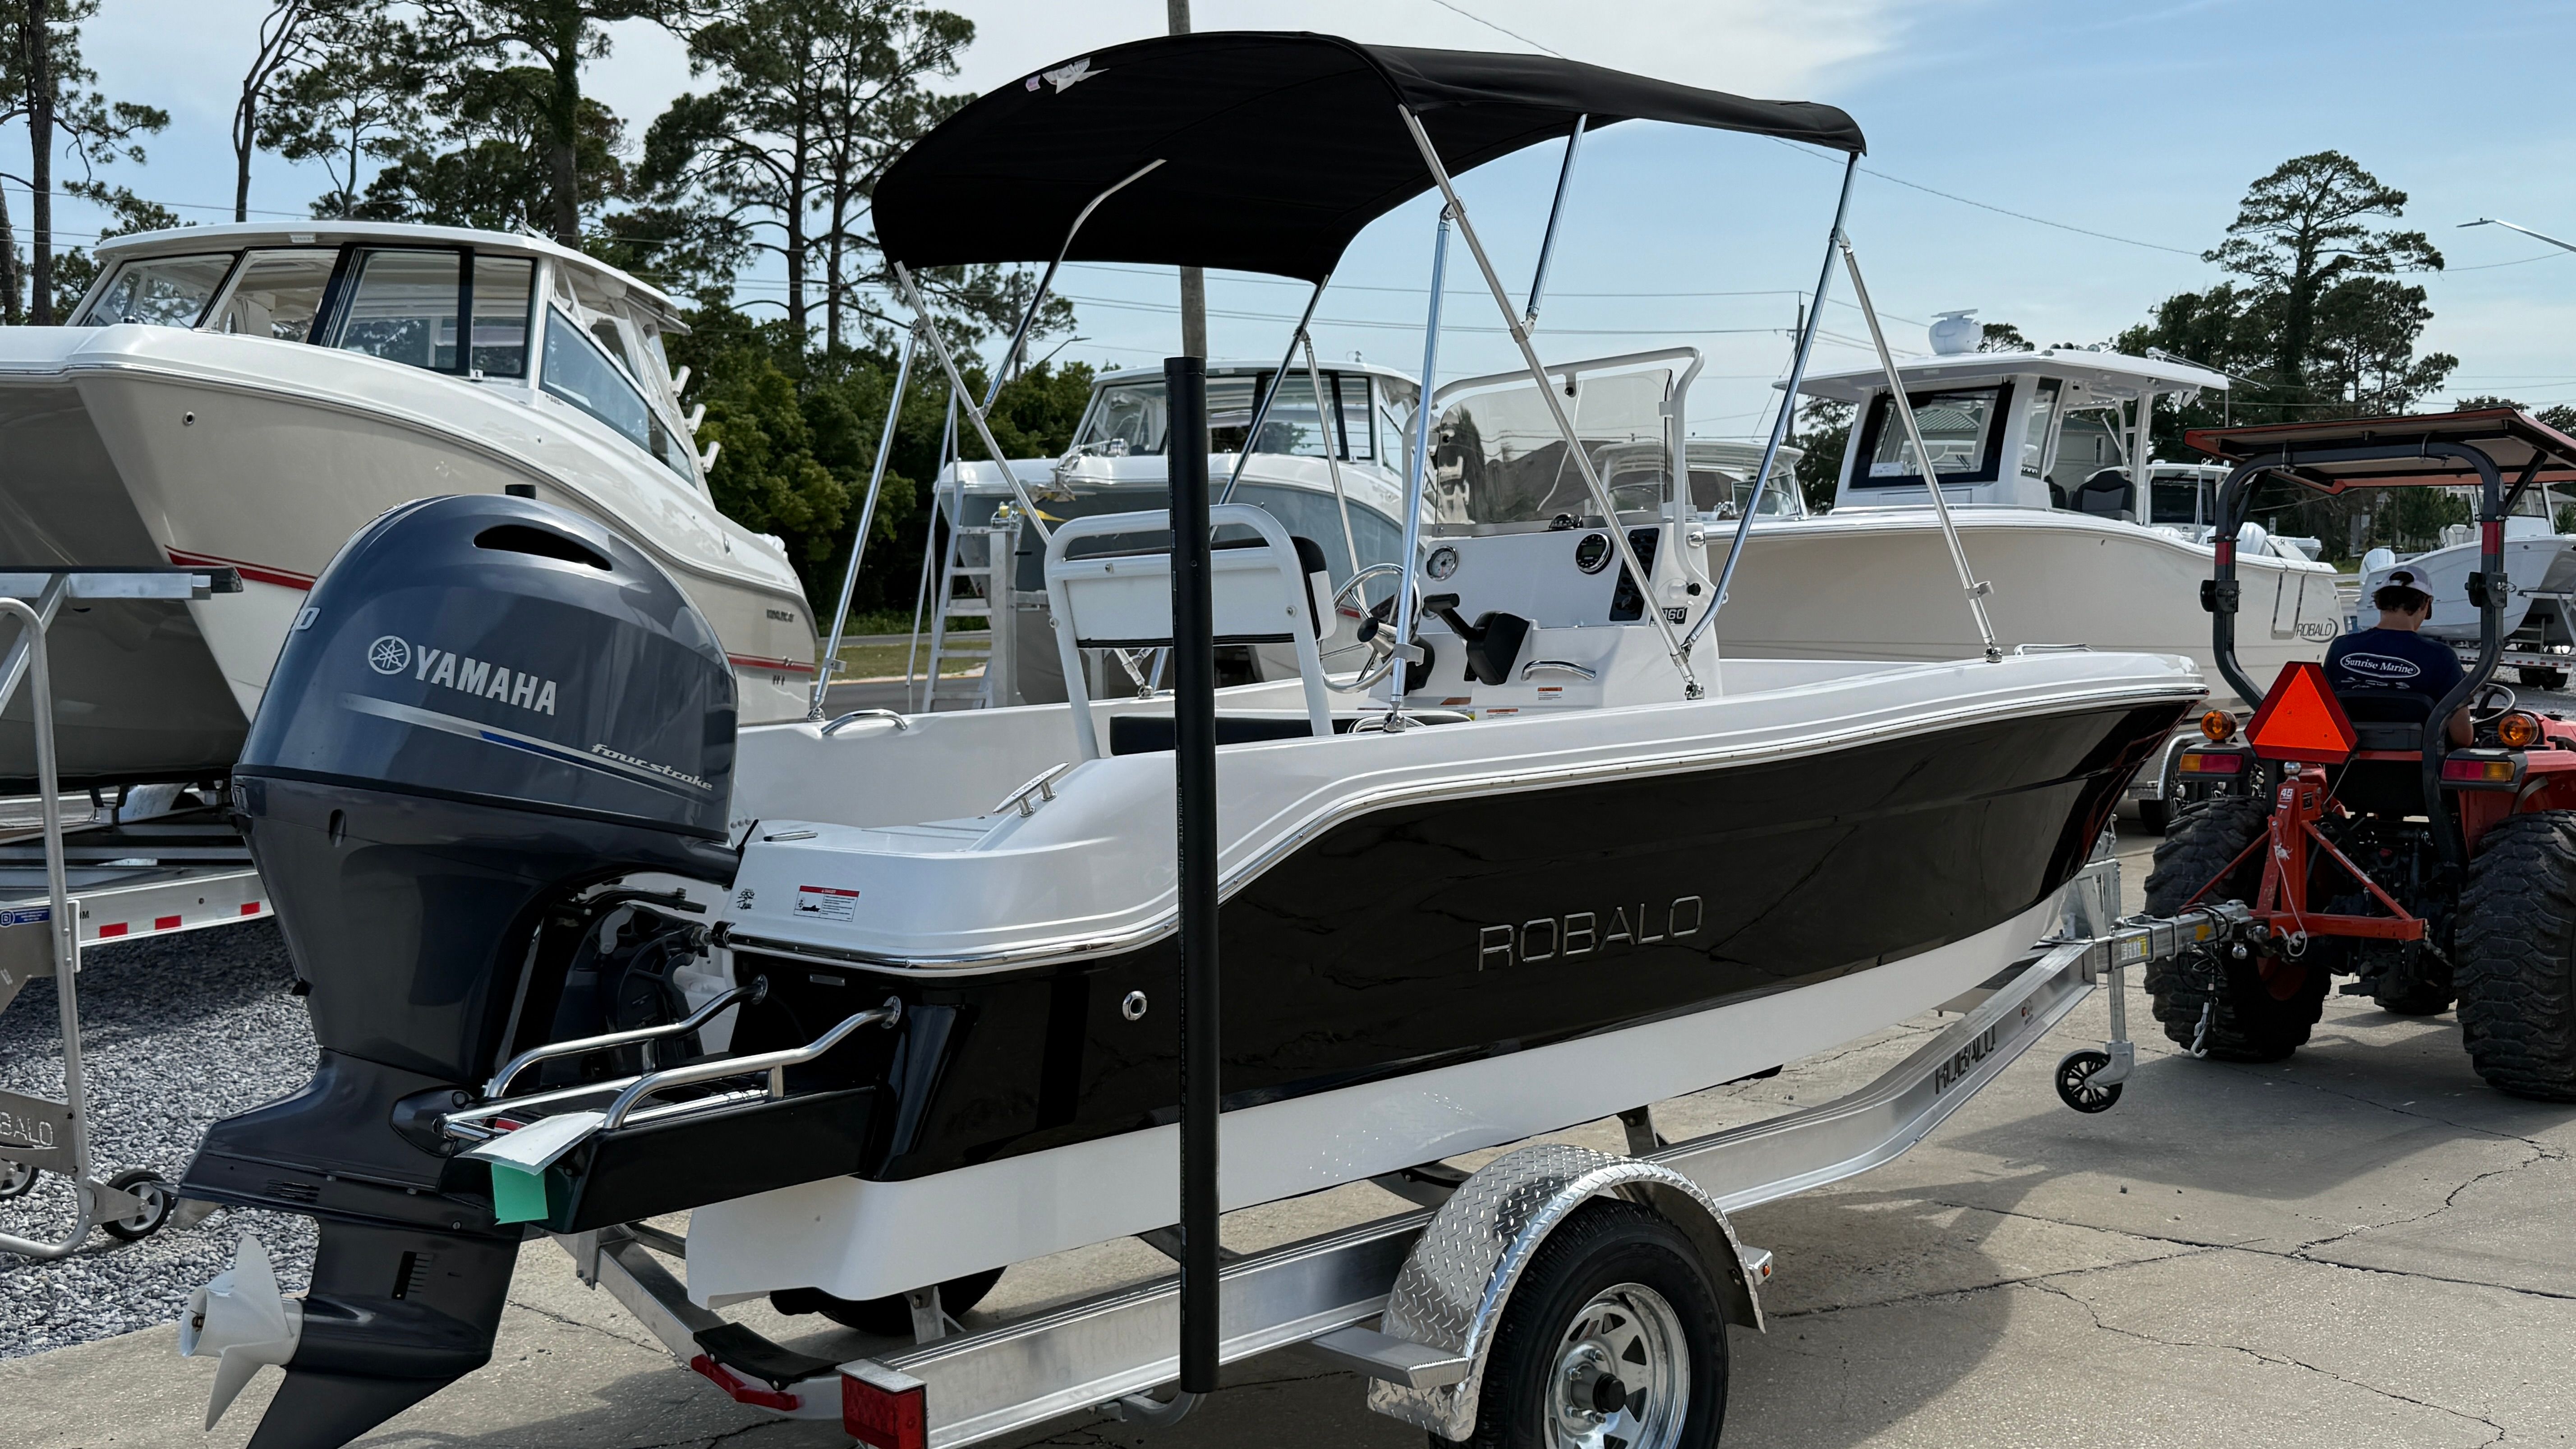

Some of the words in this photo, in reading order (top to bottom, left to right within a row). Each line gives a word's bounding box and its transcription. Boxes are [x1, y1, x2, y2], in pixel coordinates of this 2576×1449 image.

[293, 607, 321, 630] 0
[2296, 623, 2332, 637] ROBALO
[2345, 657, 2378, 669] Sunrise
[2379, 662, 2414, 674] Marine
[415, 645, 557, 715] YAMAHA
[1012, 772, 1049, 797] ROBALO
[1478, 896, 1703, 971] ROBALO
